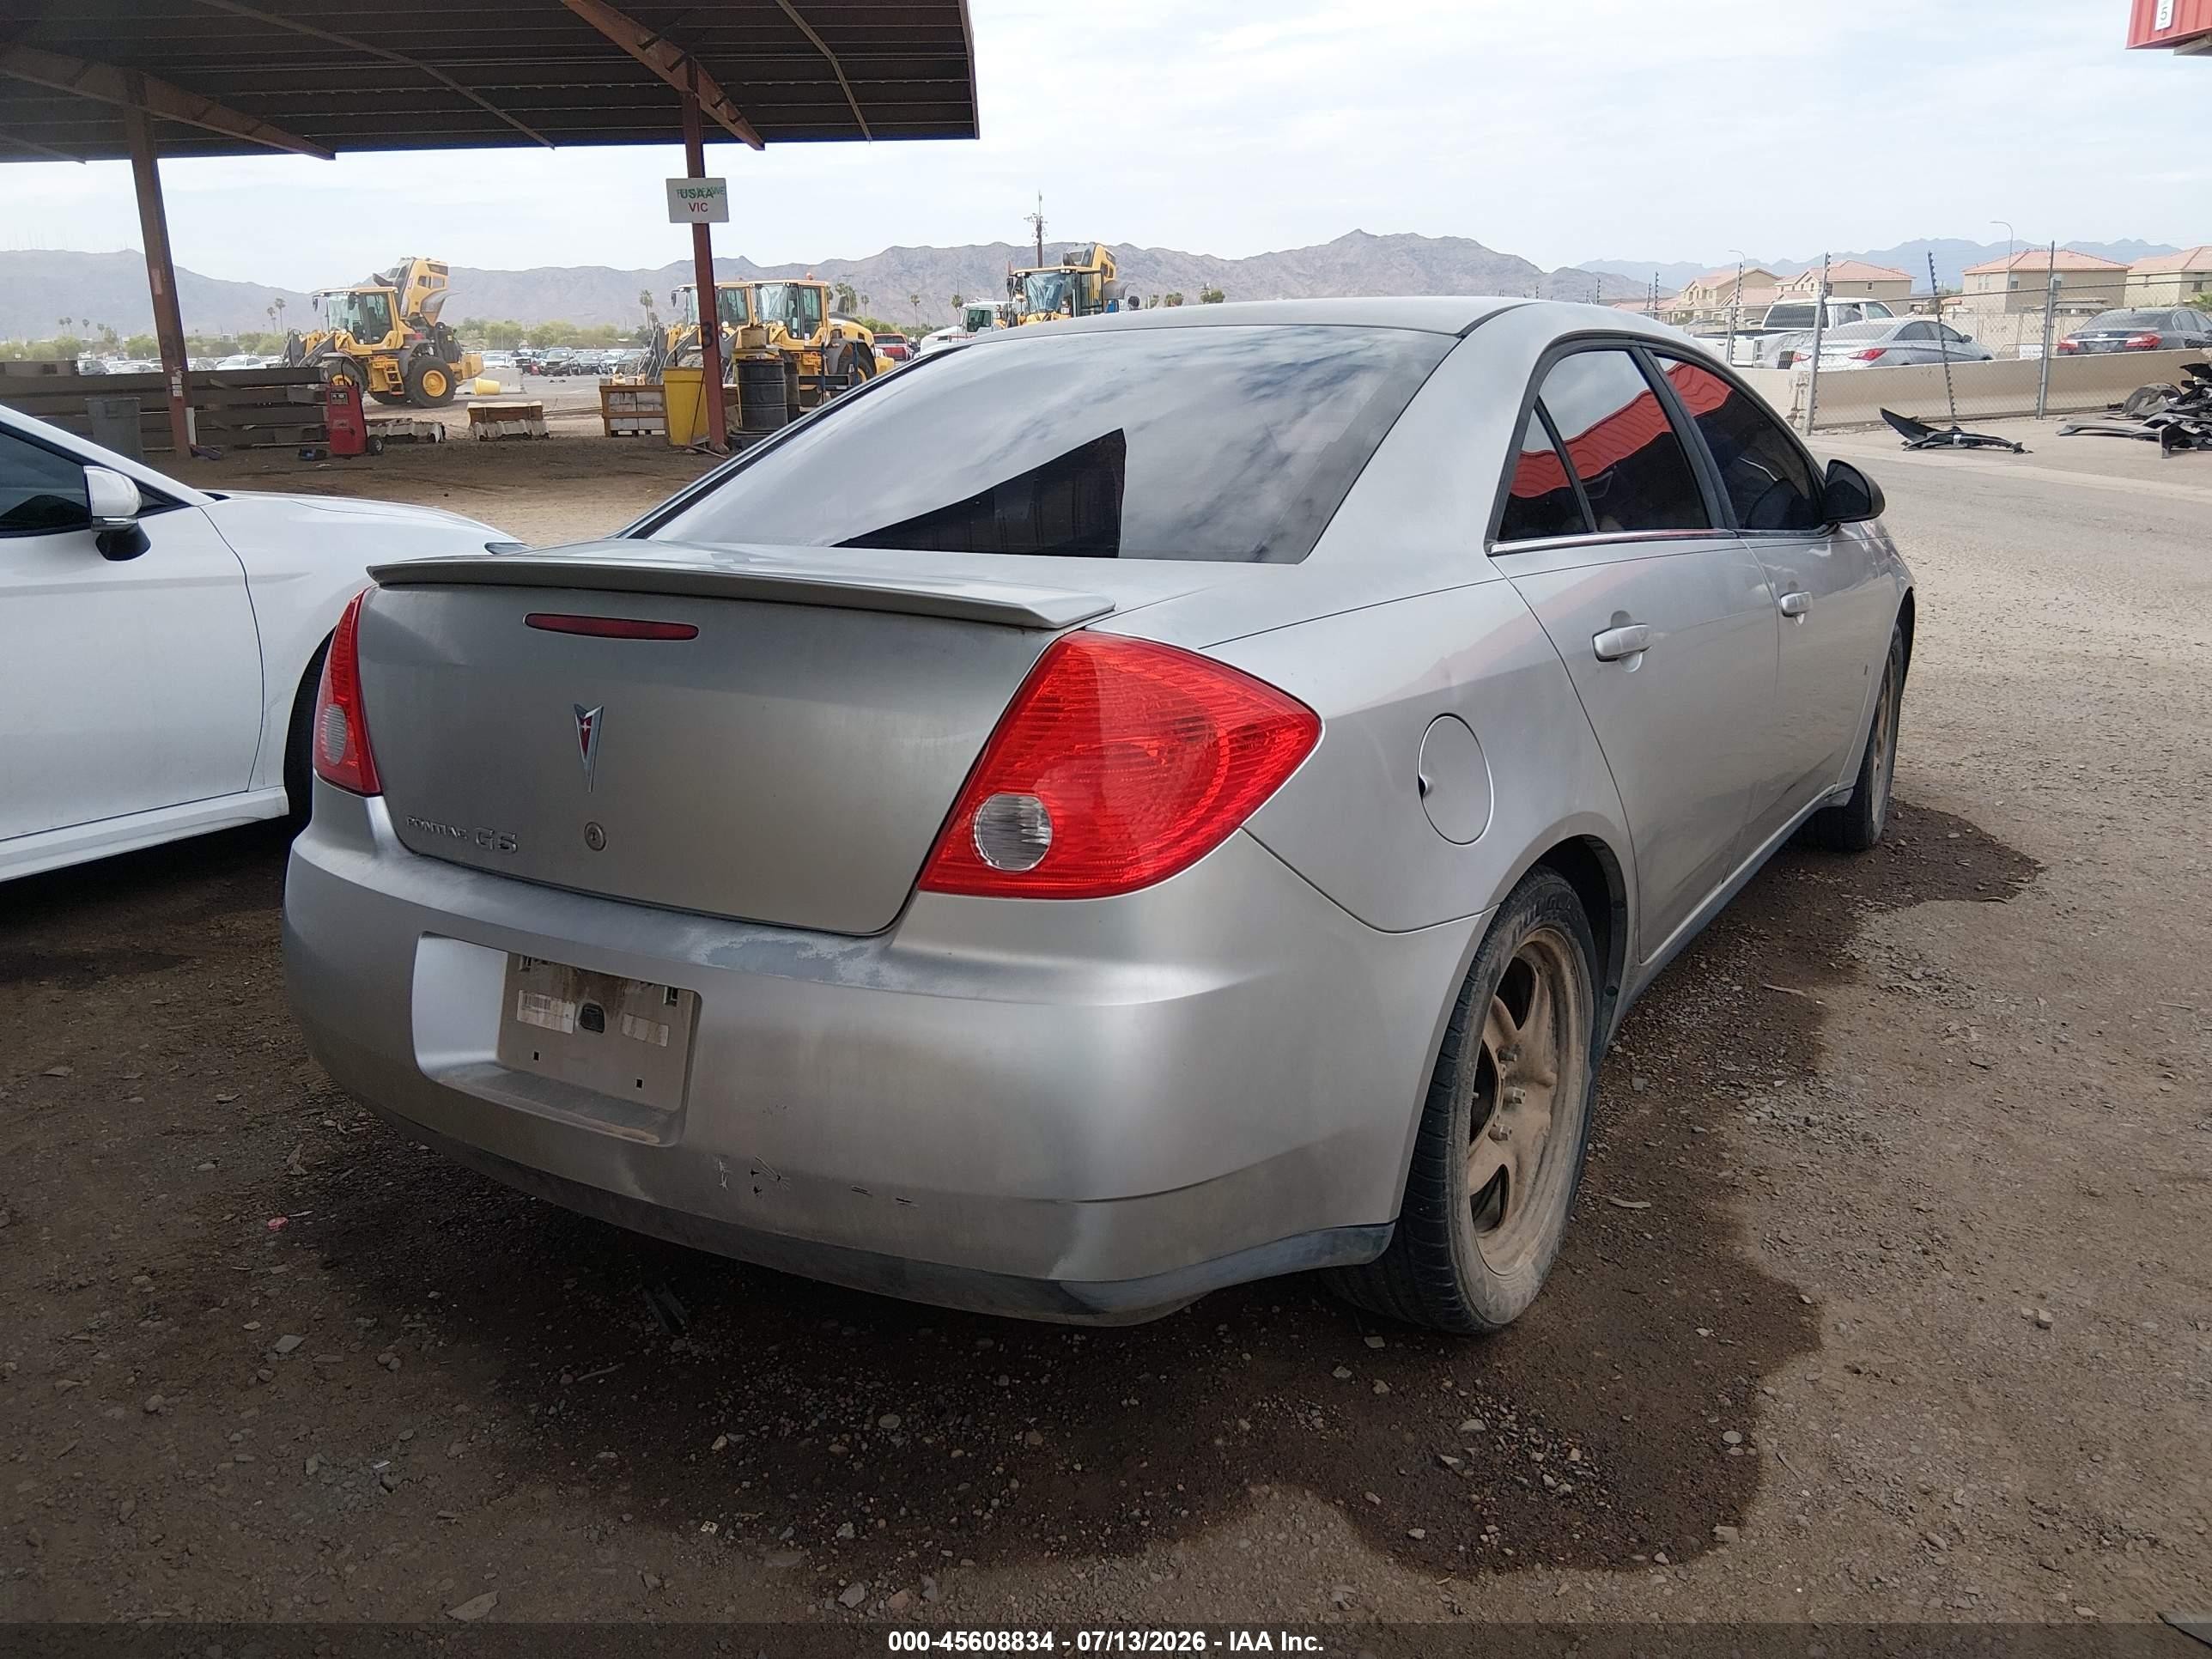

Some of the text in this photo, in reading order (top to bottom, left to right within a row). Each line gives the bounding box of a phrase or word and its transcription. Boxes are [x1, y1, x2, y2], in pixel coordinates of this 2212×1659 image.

[680, 188, 714, 199] USAA
[688, 202, 708, 213] VIC
[702, 321, 714, 348] 3
[406, 815, 519, 853] PONTIAC G6
